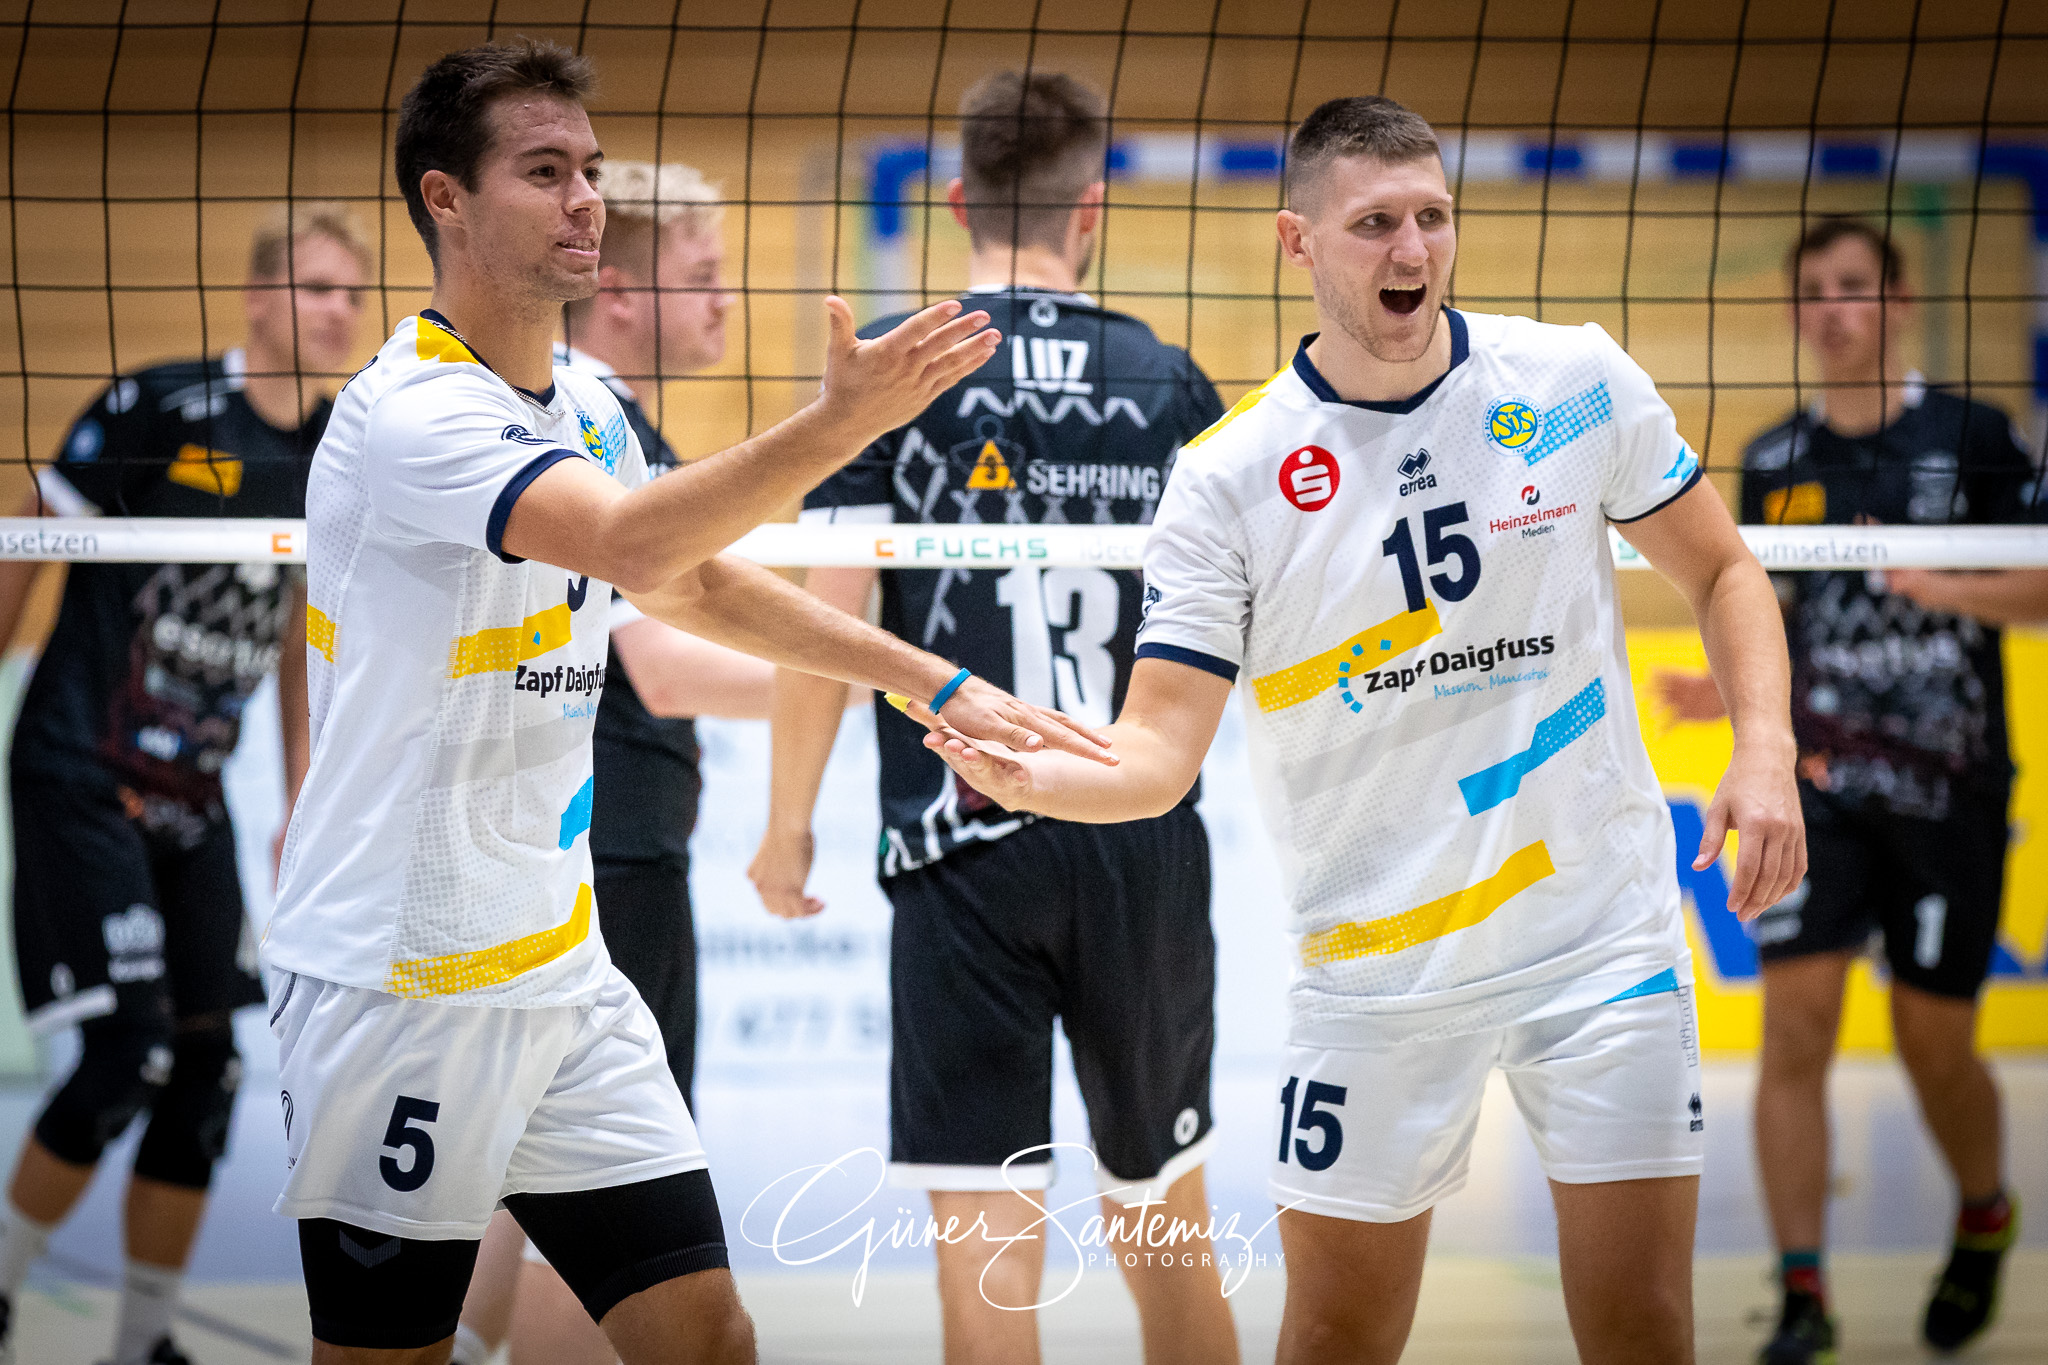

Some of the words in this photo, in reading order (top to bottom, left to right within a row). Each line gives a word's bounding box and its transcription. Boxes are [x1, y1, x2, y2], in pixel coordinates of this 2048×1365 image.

[1008, 335, 1093, 394] LUZ
[1026, 459, 1160, 500] SEHRING
[0, 528, 98, 553] setzen
[1489, 502, 1577, 534] Heinzelmann
[1521, 524, 1555, 539] Medien
[915, 537, 1048, 559] FUCHS
[1382, 501, 1481, 613] 15
[996, 568, 1120, 730] 13
[1364, 659, 1427, 694] Zapf
[1430, 635, 1556, 674] Daigfuss
[515, 665, 563, 698] Zapf
[565, 662, 606, 697] Daigfu
[379, 1094, 440, 1192] 5
[1278, 1075, 1348, 1172] 15
